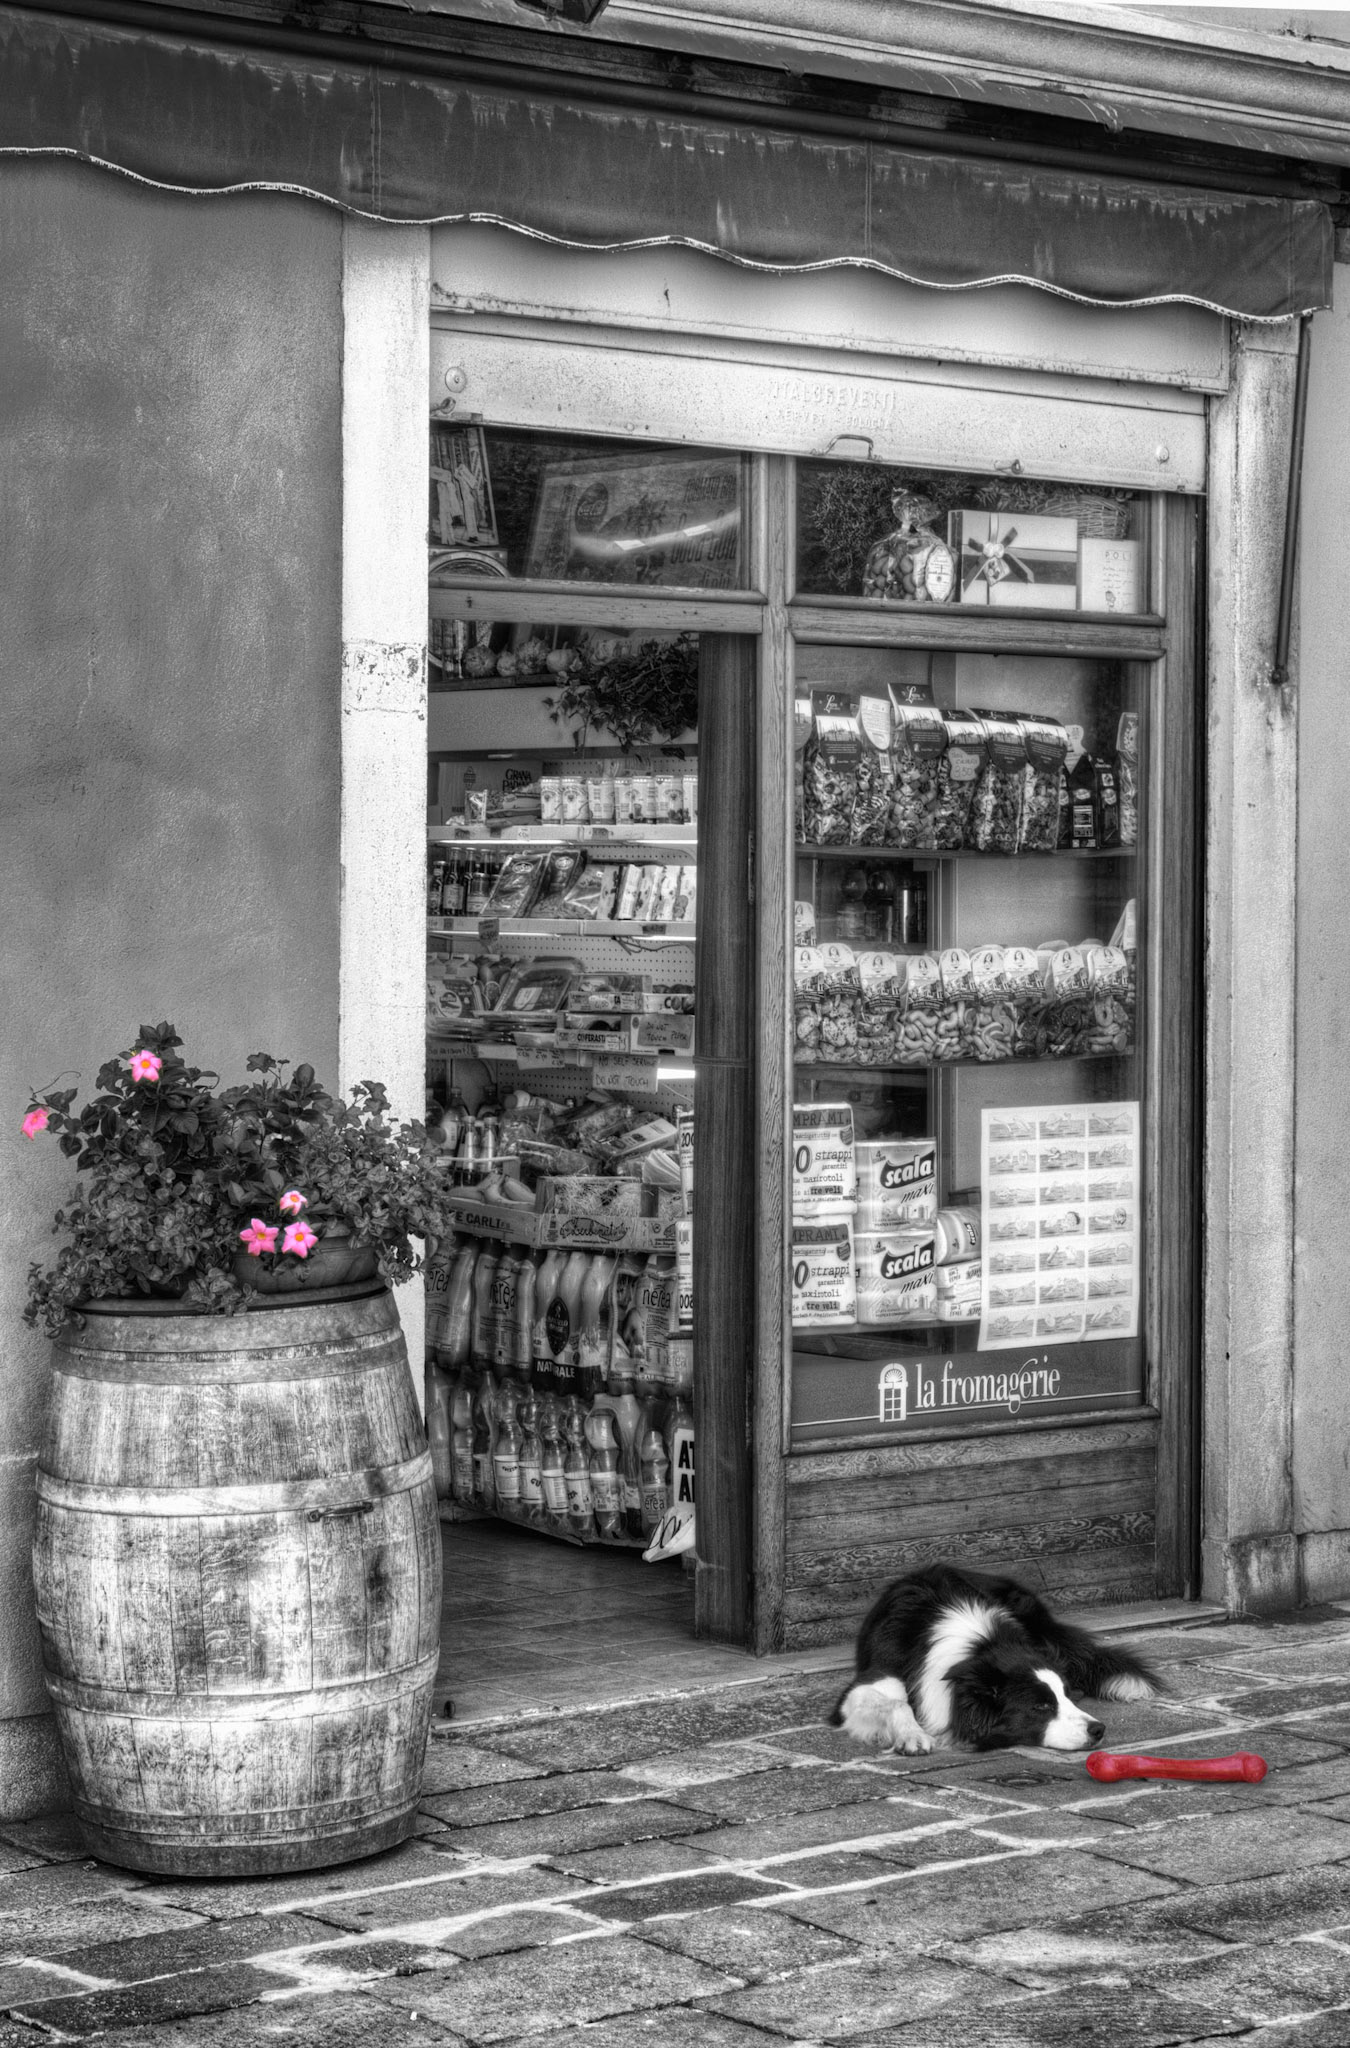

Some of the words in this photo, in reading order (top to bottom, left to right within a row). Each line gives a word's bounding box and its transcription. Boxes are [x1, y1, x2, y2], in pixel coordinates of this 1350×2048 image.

[613, 1056, 629, 1067] SELF
[595, 1073, 606, 1086] DO
[607, 1073, 620, 1086] NOT
[624, 1076, 649, 1088] TOUCH
[815, 1148, 852, 1162] strappi
[885, 1154, 932, 1187] scala
[825, 1185, 841, 1195] veli
[900, 1182, 934, 1204] maxi
[885, 1244, 931, 1277] scala
[811, 1263, 849, 1278] strappi
[900, 1270, 933, 1294] maxi
[823, 1301, 838, 1310] veli
[536, 1361, 576, 1379] NATRALE
[915, 1363, 936, 1409] la
[941, 1355, 1061, 1414] fromagerie
[644, 1500, 665, 1511] erea
